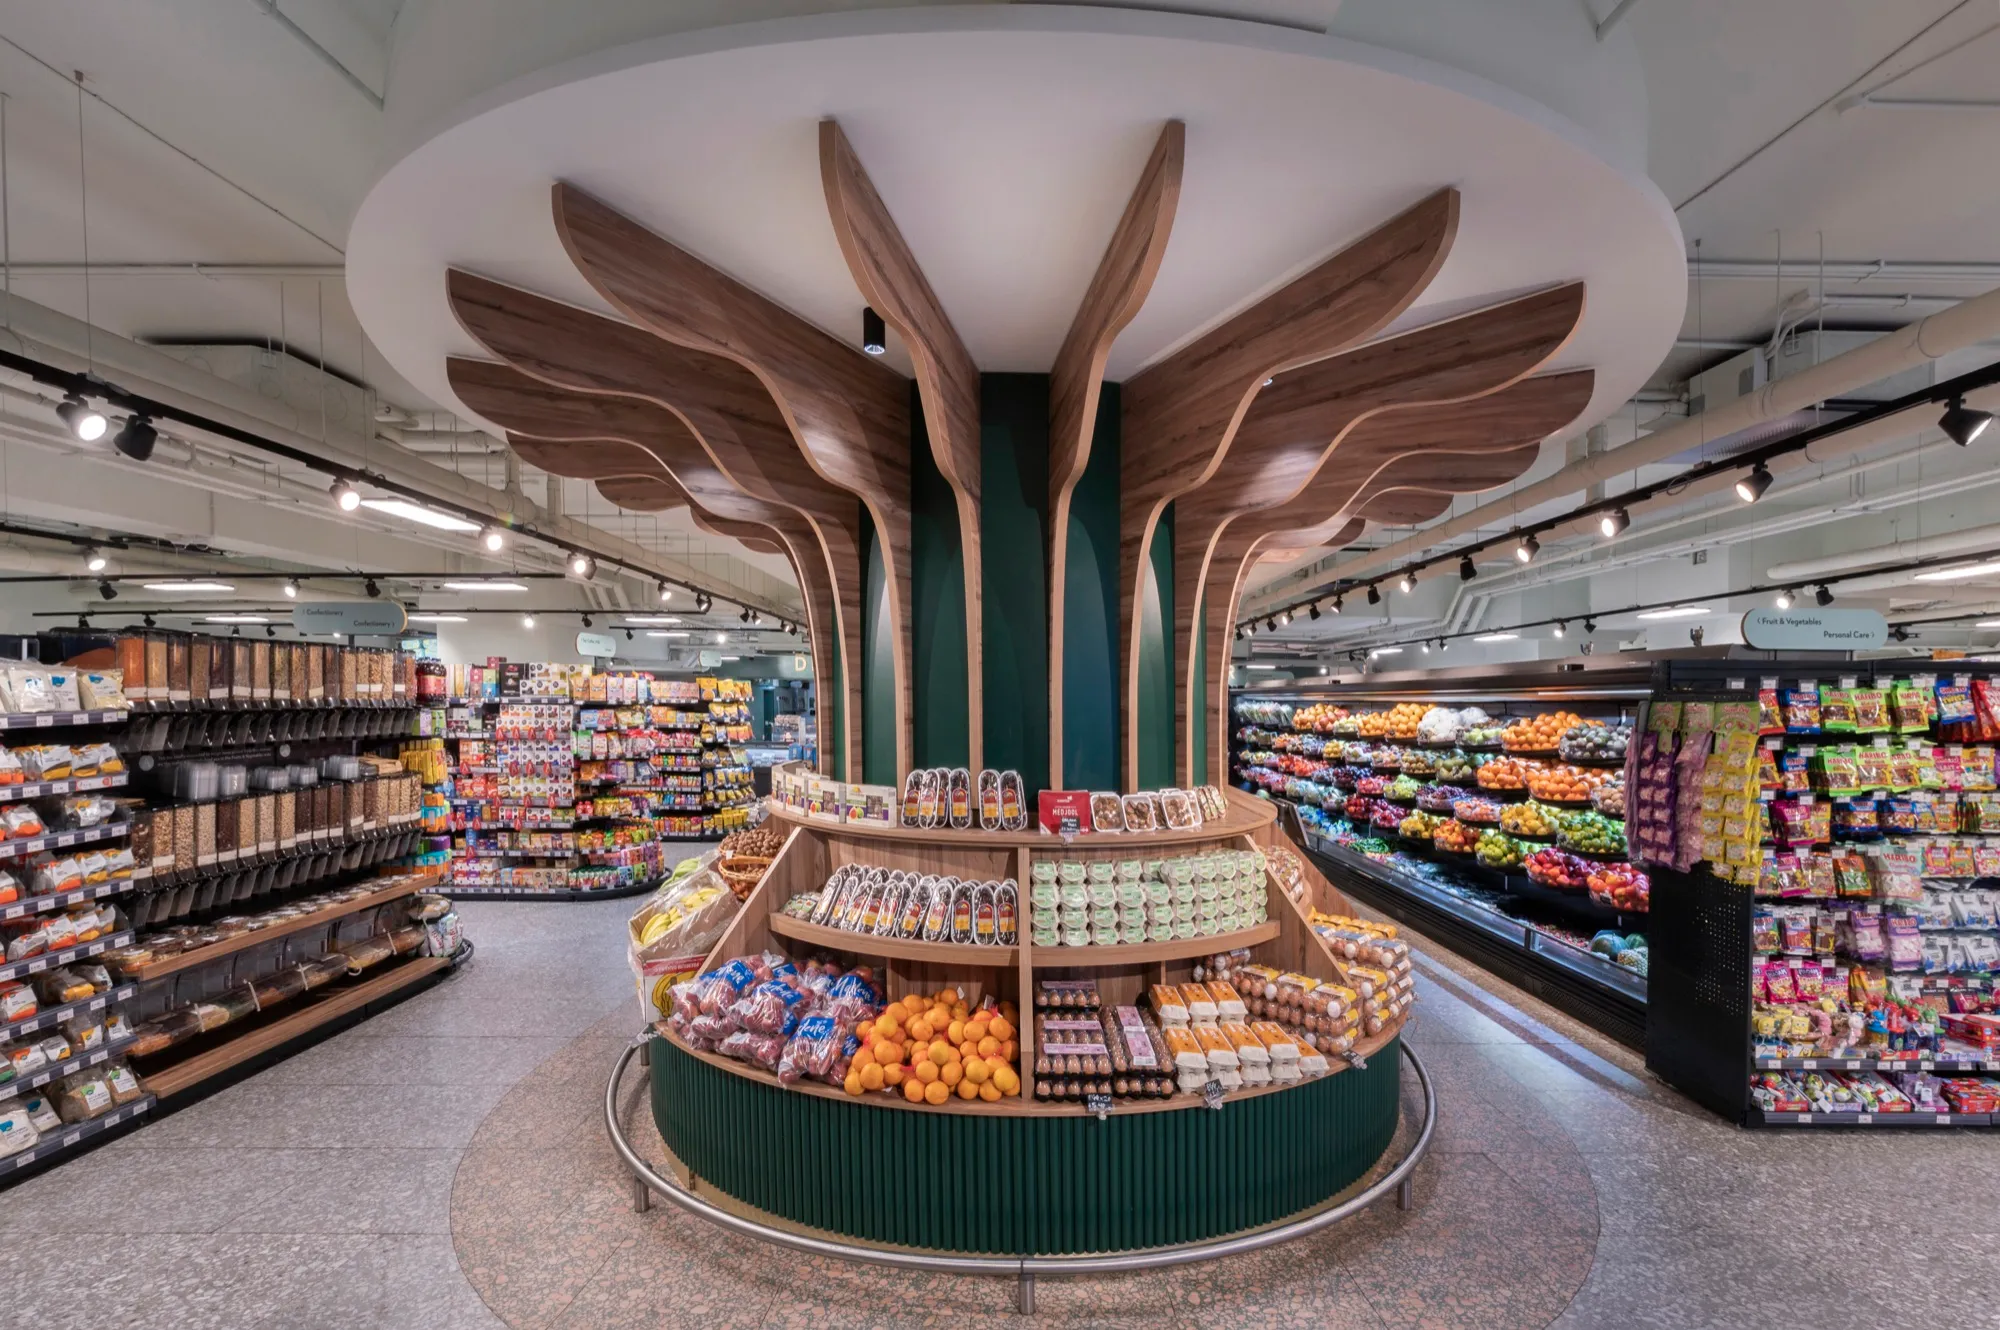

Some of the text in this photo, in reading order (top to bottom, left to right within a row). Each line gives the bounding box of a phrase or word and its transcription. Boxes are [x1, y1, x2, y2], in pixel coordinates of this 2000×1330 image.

[1762, 617, 1822, 627] Fruit & Vegetables
[1823, 630, 1870, 639] Personal Care
[1855, 692, 1883, 700] HARIBO
[1859, 751, 1887, 760] HARIBO
[1052, 808, 1079, 816] MEDJOOL
[1883, 853, 1916, 863] HARIBO
